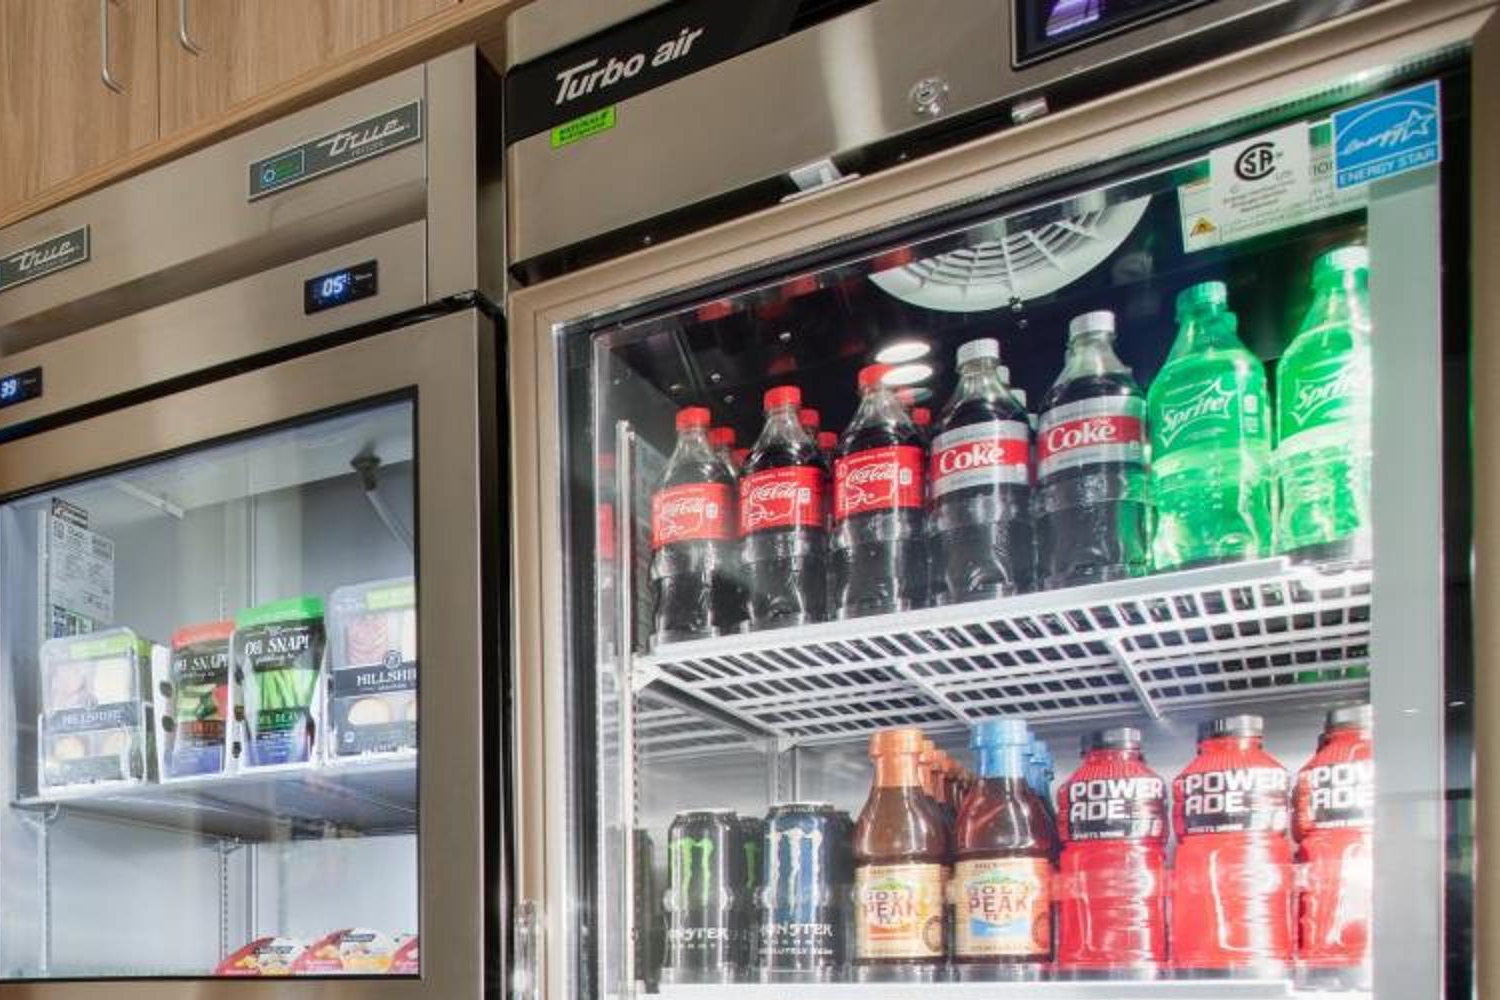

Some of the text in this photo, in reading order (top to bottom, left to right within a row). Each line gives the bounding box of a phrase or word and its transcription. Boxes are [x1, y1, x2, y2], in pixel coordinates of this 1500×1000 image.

[555, 26, 705, 105] Turbo air
[316, 119, 405, 157] True
[1339, 161, 1398, 184] ENERGY
[1399, 147, 1436, 172] STAR
[10, 240, 75, 271] True
[1162, 384, 1235, 430] Sprite
[1046, 420, 1117, 454] Coke
[938, 441, 1005, 476] Coke
[244, 633, 310, 656] OH SNAP!
[1069, 776, 1164, 803] POWER
[1184, 766, 1287, 795] POWER
[1311, 763, 1373, 789] POW
[969, 898, 1029, 914] PEAK
